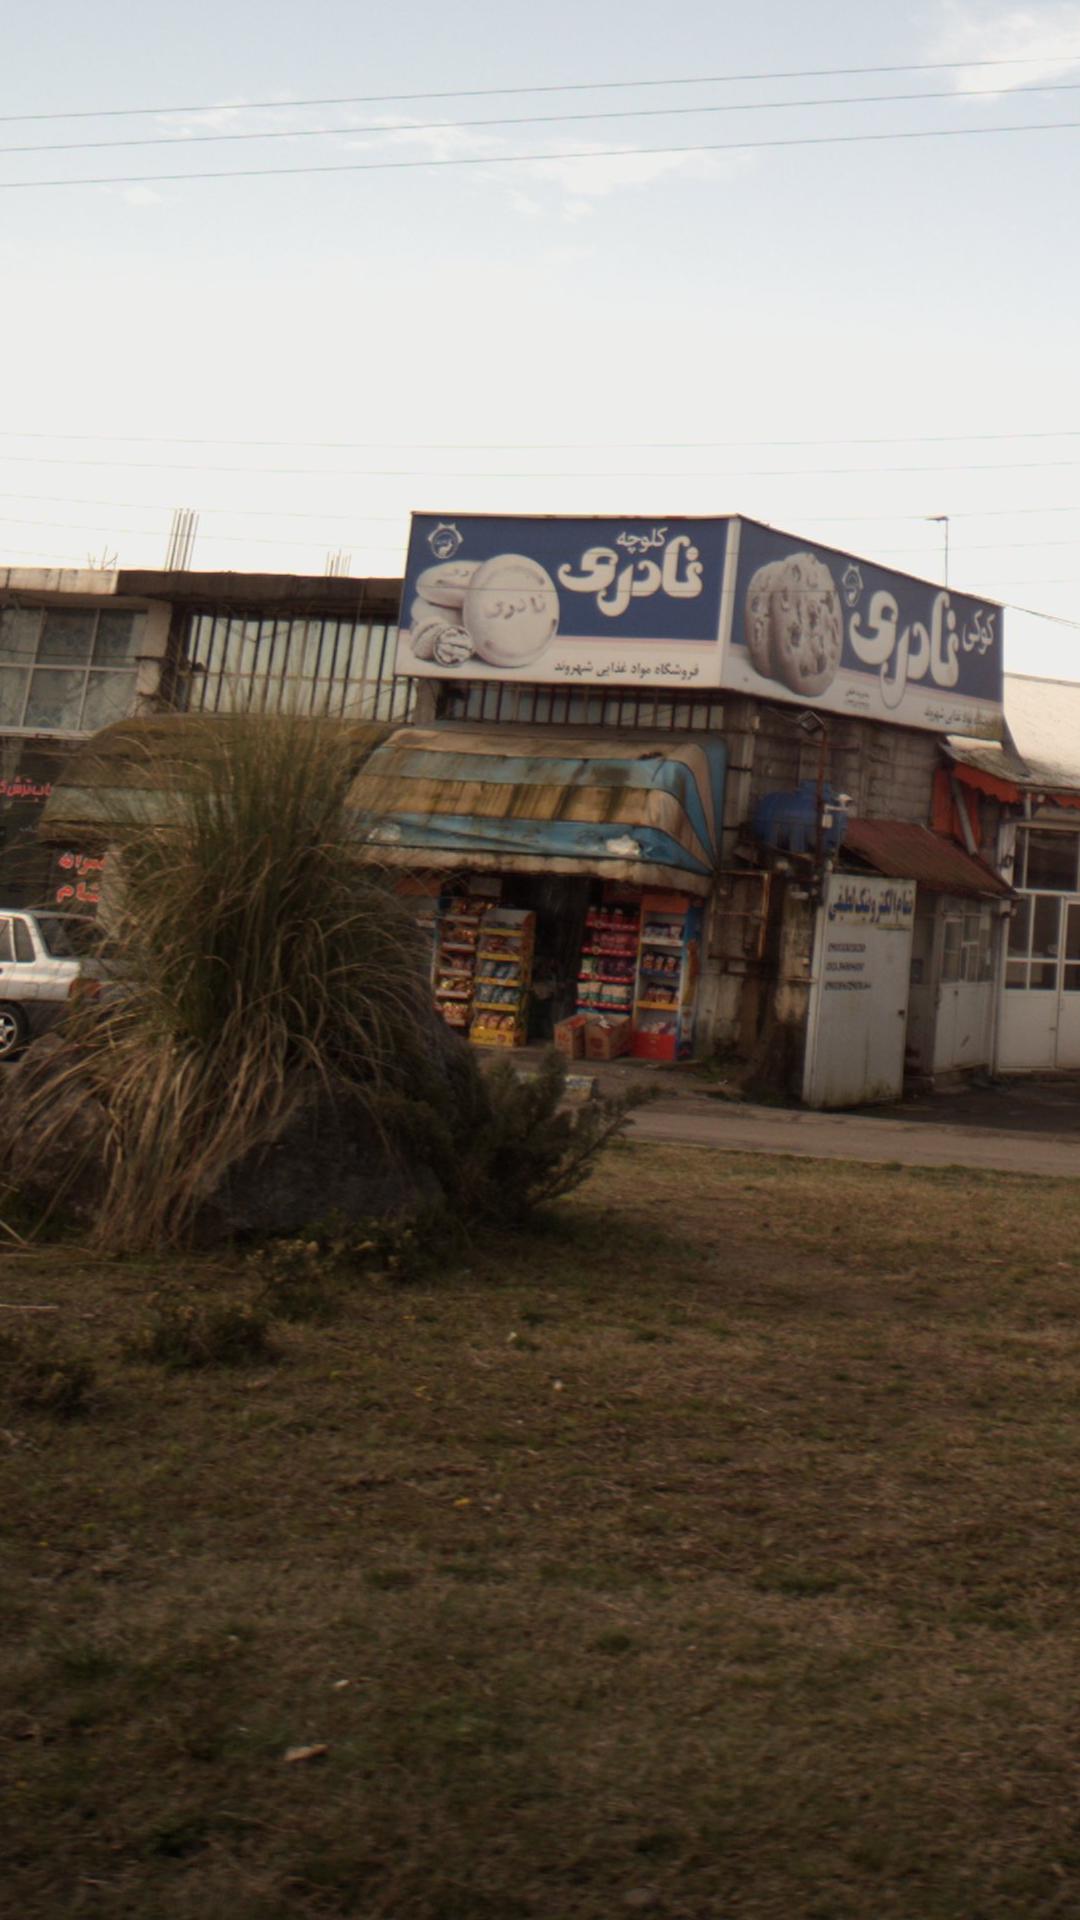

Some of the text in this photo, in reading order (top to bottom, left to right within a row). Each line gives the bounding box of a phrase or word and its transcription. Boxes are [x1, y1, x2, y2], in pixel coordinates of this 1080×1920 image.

[617, 526, 668, 554] کلوچه
[557, 535, 703, 617] نادری
[962, 609, 995, 655] کوکی
[851, 590, 959, 709] نادری
[554, 660, 593, 676] شهروند
[630, 662, 651, 679] مواد
[655, 662, 699, 680] فروشگاه
